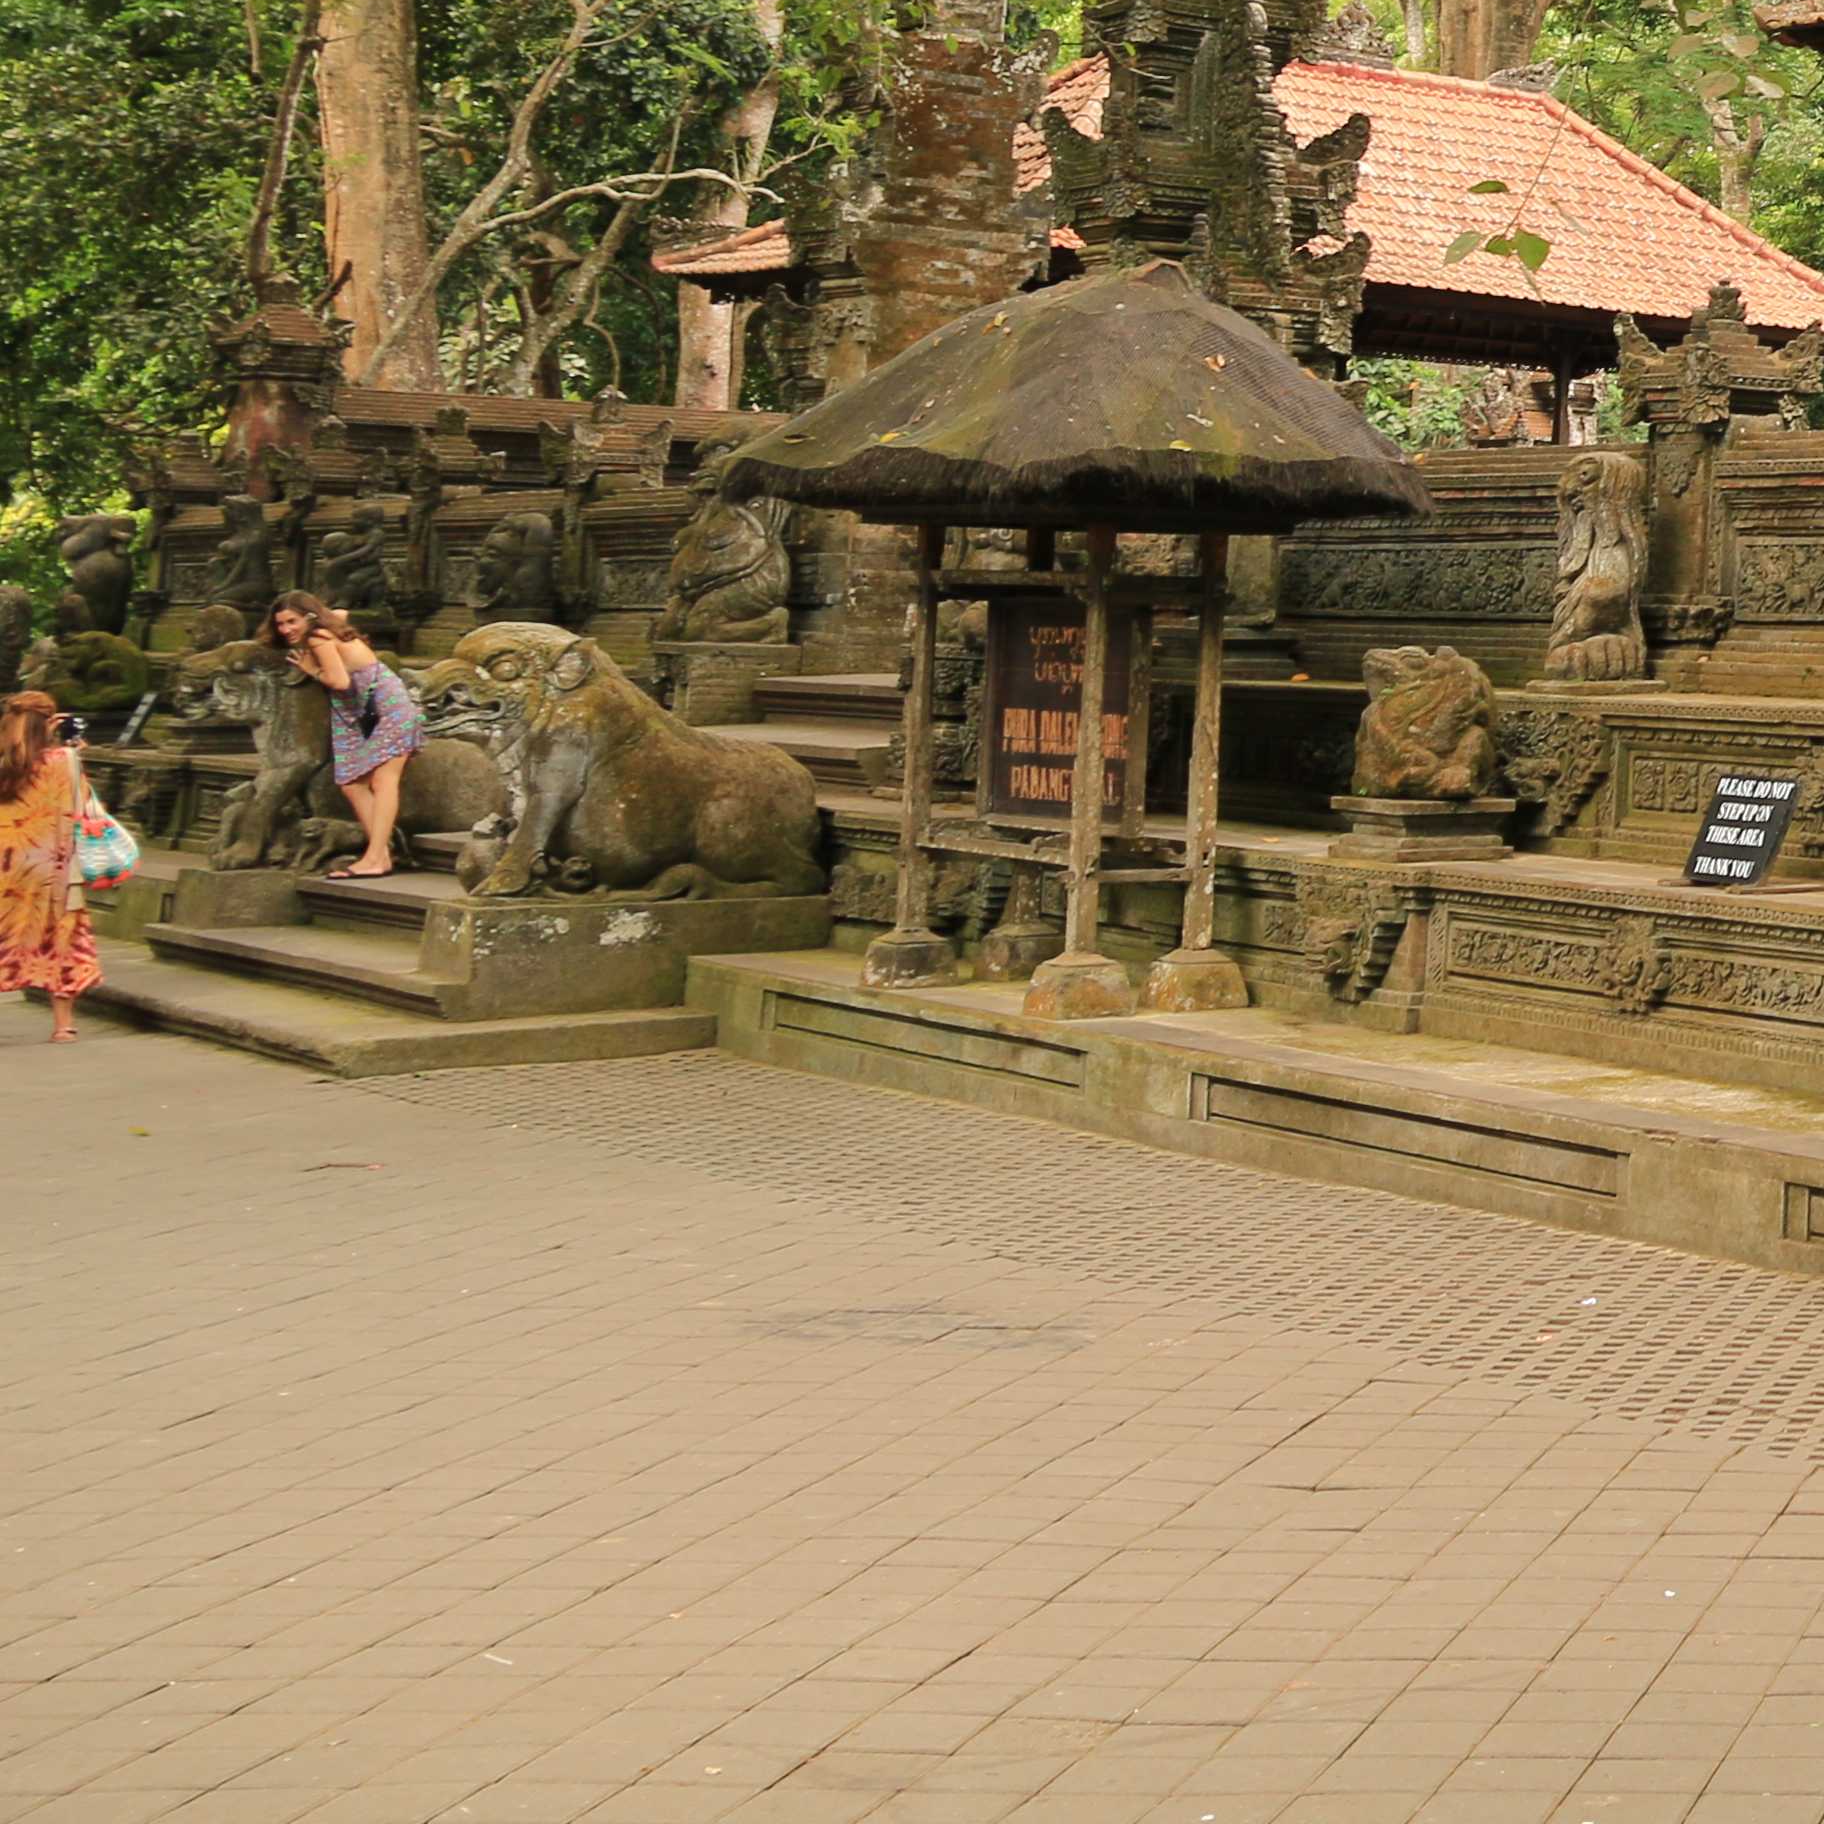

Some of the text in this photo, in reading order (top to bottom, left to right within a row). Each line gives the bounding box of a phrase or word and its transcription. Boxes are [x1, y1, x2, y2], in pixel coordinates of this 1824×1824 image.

[1040, 709, 1080, 756] DALE
[1716, 777, 1796, 800] PLEASE DO NOT
[1716, 801, 1775, 822] STEP UP ON
[1705, 824, 1766, 847] THESE AREA
[1693, 856, 1756, 878] THANK YOU
